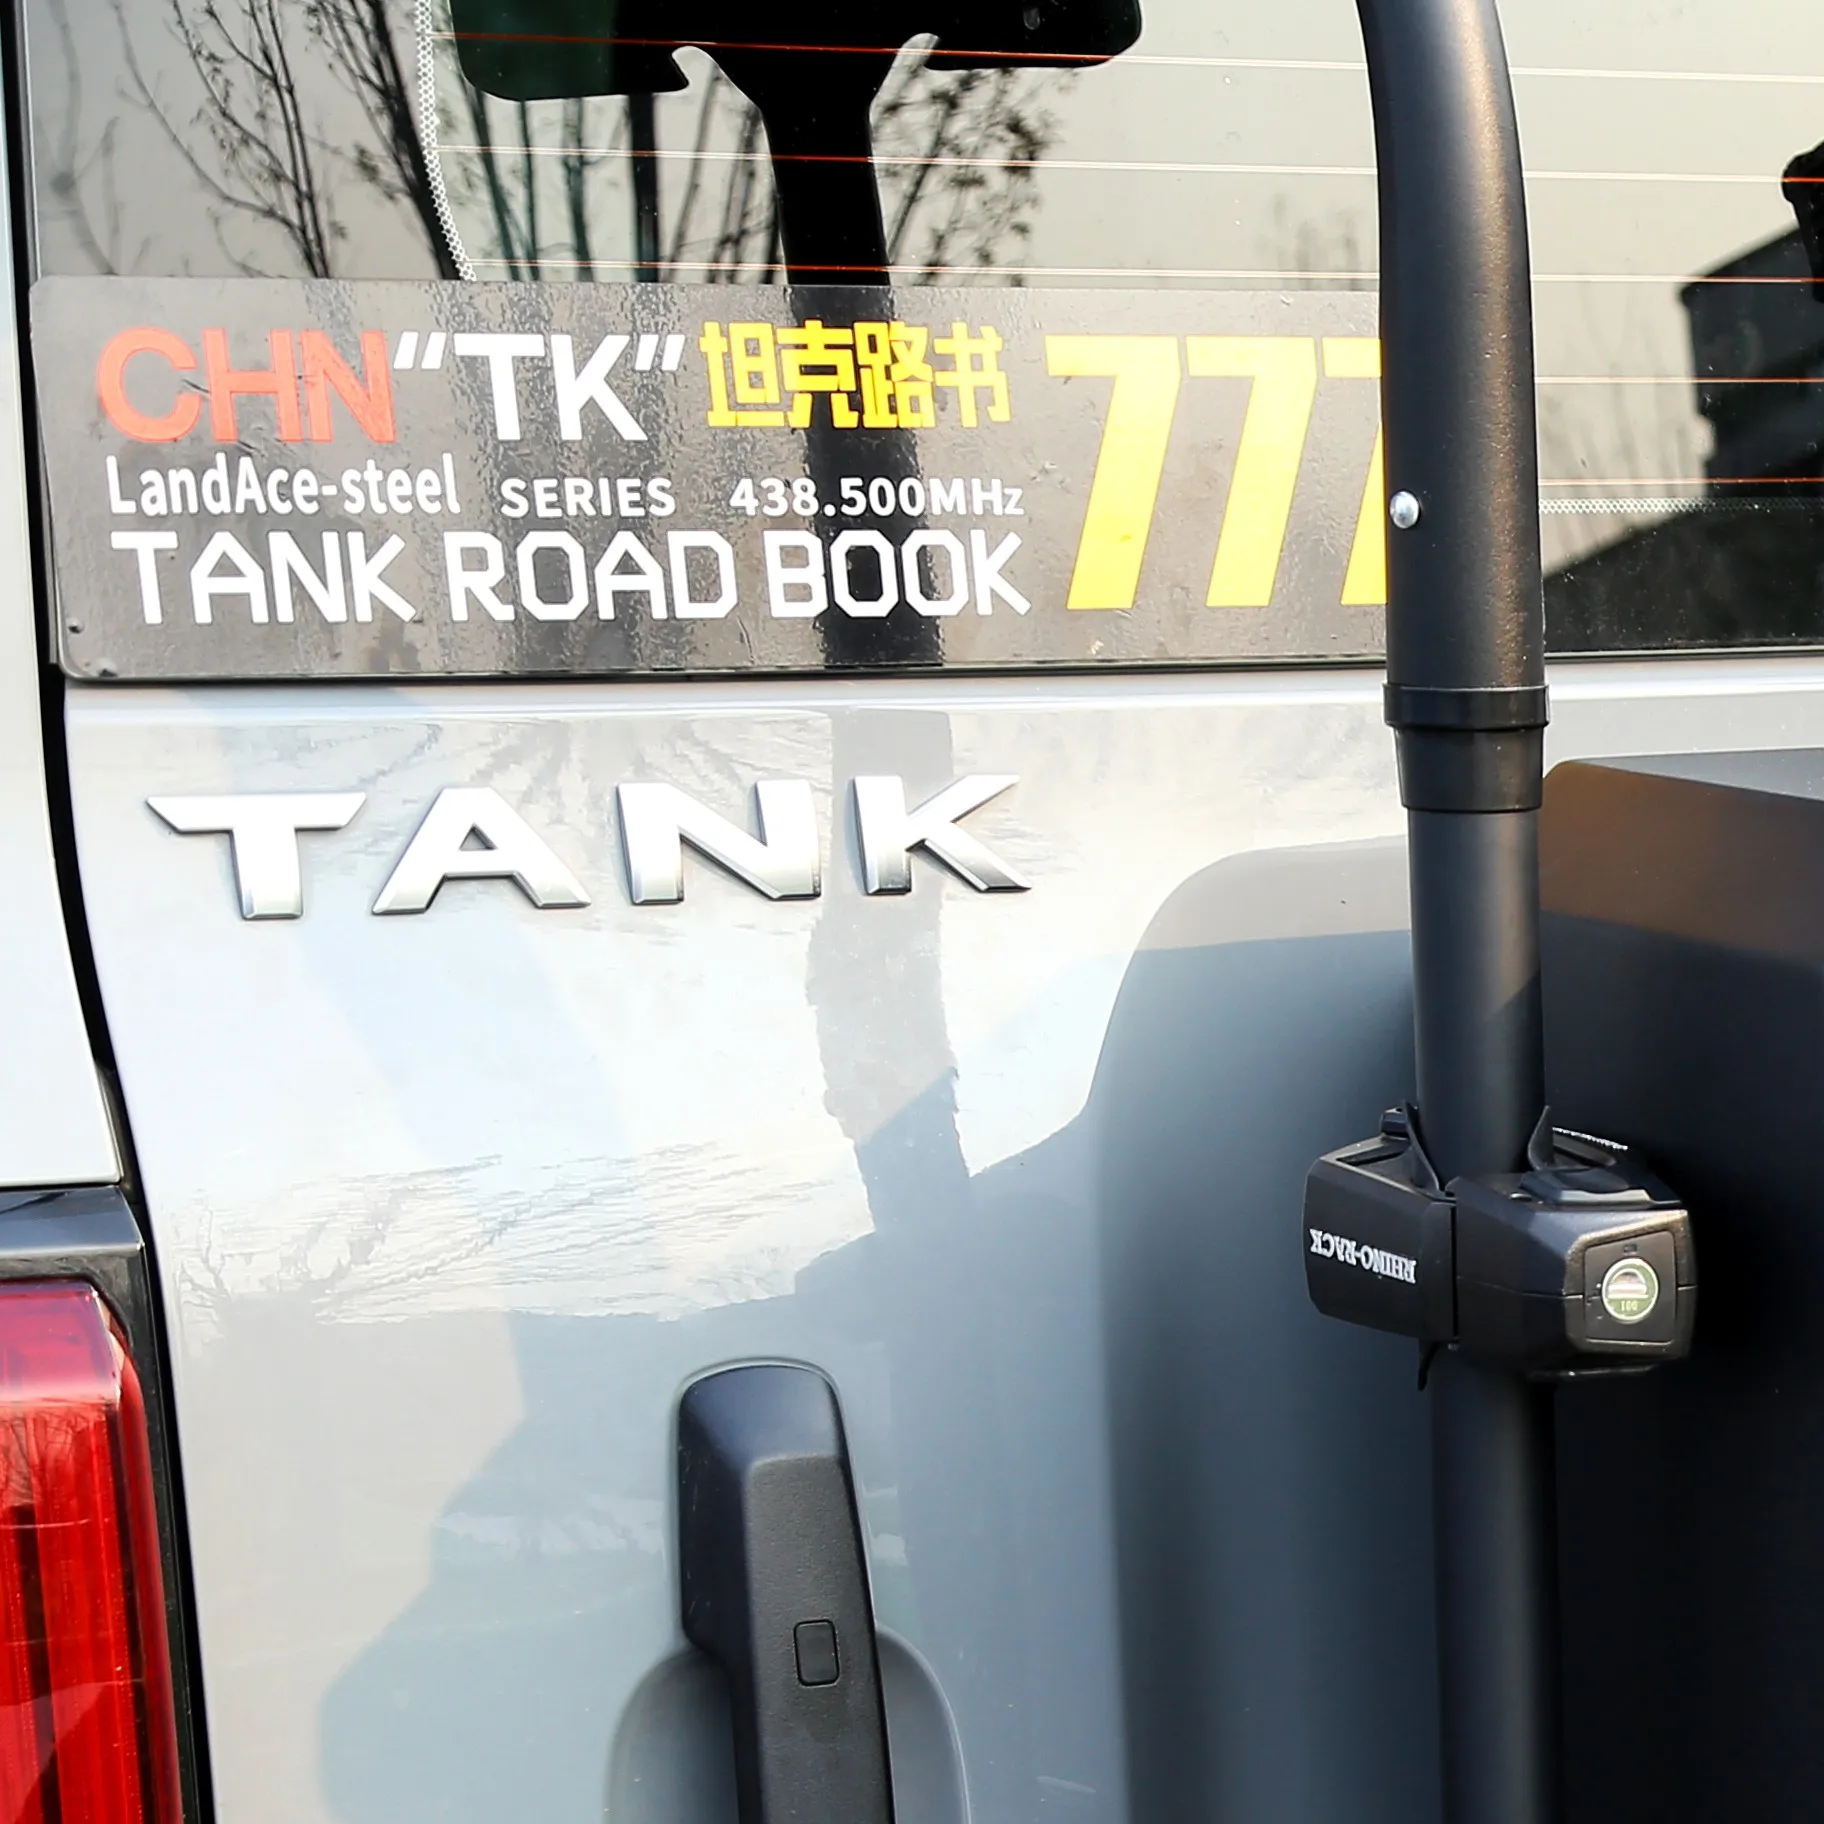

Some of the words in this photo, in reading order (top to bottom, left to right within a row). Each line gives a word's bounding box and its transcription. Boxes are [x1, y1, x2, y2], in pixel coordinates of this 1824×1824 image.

[699, 320, 1012, 428] 坦克路书
[106, 451, 461, 517] LandAce-steel
[500, 477, 675, 518] SERIES
[729, 477, 1026, 517] 438.500MHz
[110, 530, 418, 625] TANK
[443, 529, 738, 622] ROAD
[763, 529, 1032, 618] BOOK
[146, 774, 1032, 919] TANK
[1310, 1228, 1417, 1284] RHINO-RACK
